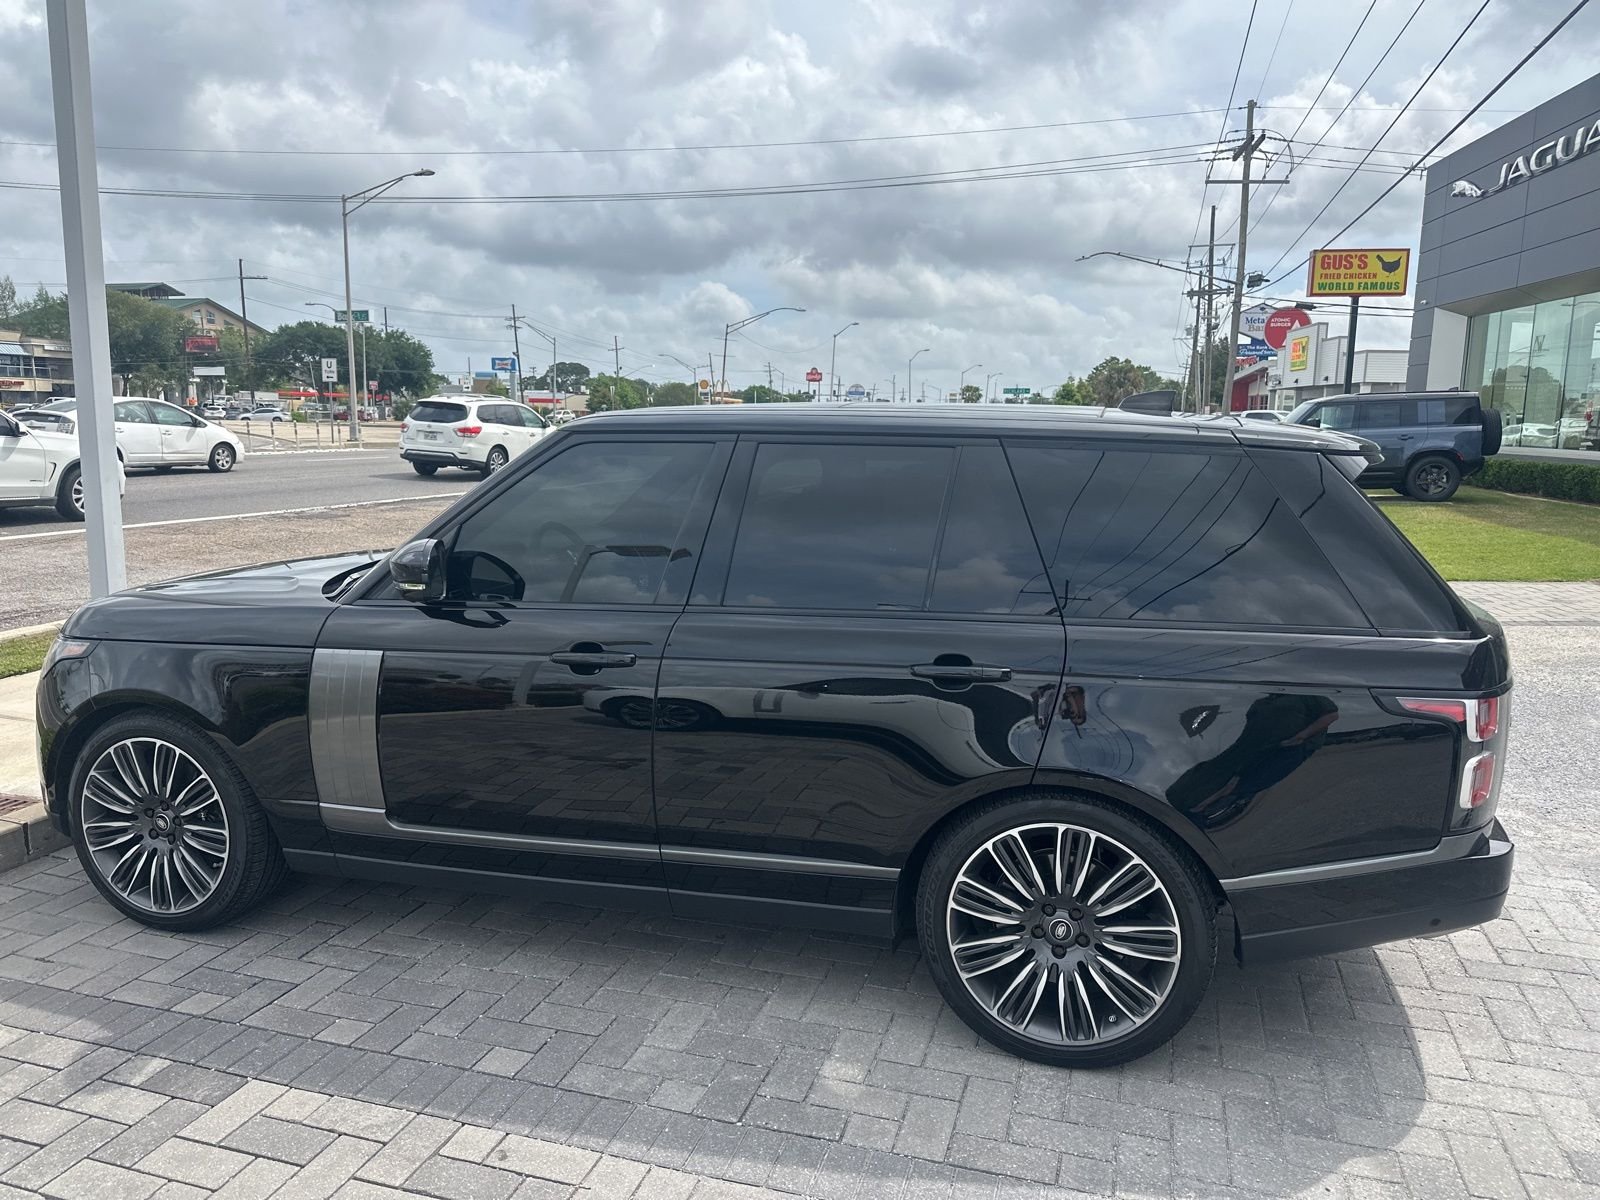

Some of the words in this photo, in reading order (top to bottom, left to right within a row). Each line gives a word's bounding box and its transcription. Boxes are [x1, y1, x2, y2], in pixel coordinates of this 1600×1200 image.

[1320, 254, 1368, 270] GUS'S
[1319, 272, 1341, 280] FRIED
[1343, 272, 1377, 280] CHICKEN
[1317, 282, 1354, 291] WORLD
[1358, 281, 1400, 291] FAMOUS
[1245, 317, 1268, 325] Meta
